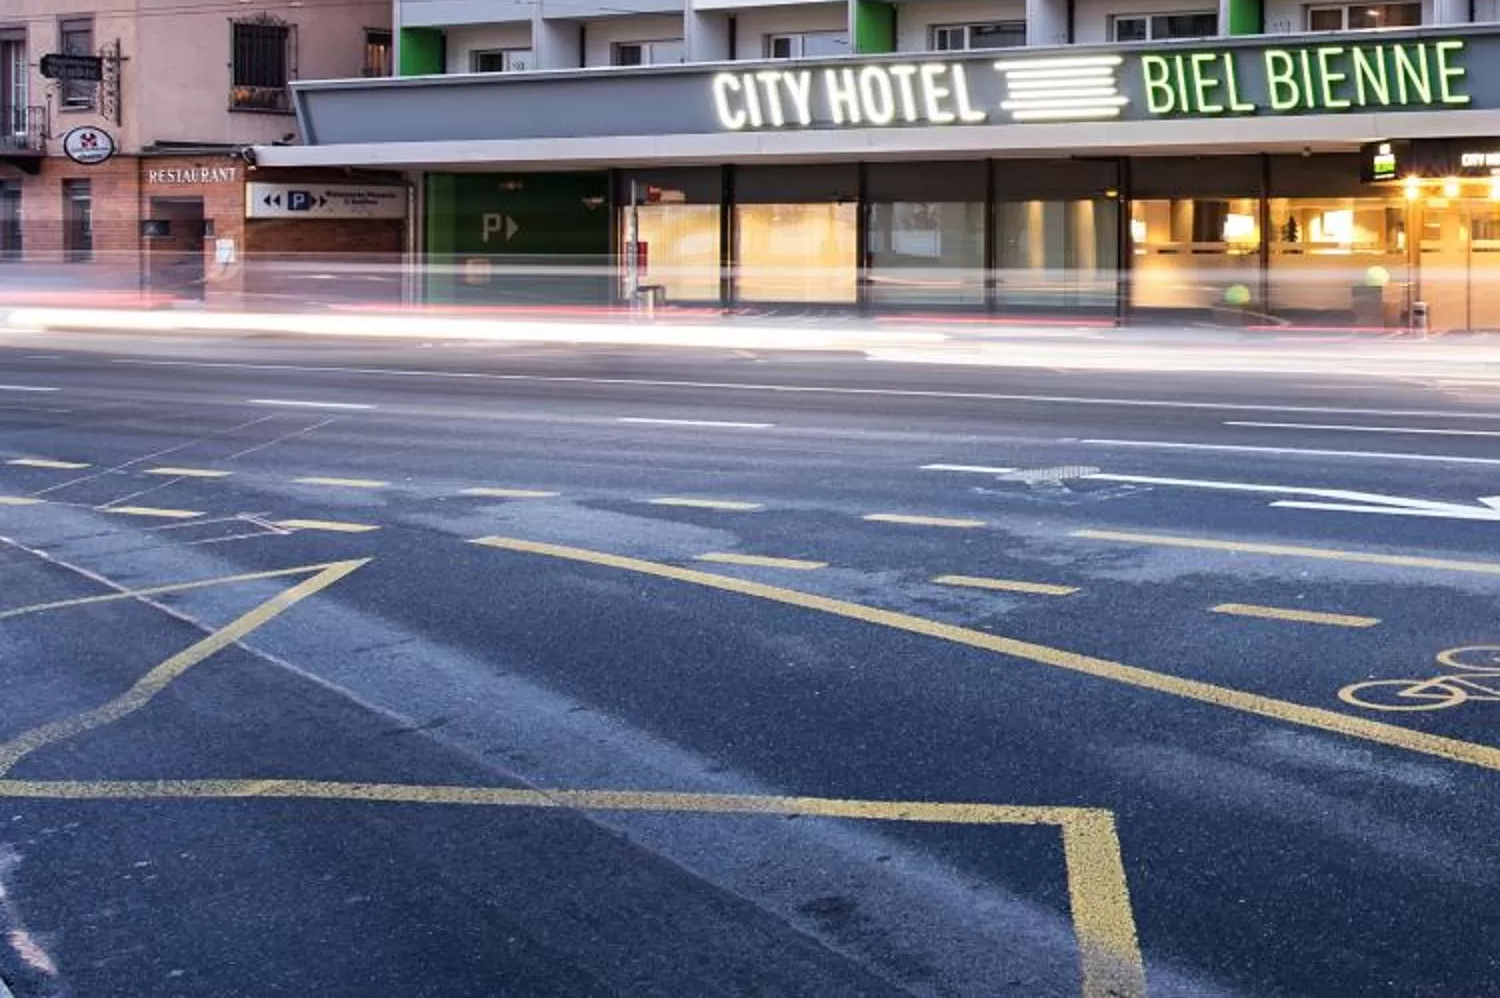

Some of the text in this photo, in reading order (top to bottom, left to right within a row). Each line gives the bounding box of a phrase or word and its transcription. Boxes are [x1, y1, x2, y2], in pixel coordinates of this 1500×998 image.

[712, 40, 1471, 130] CITY HOTEL BIEL BIENNE
[148, 167, 237, 184] RESTAURANT
[293, 193, 306, 210] P
[482, 213, 502, 243] P
